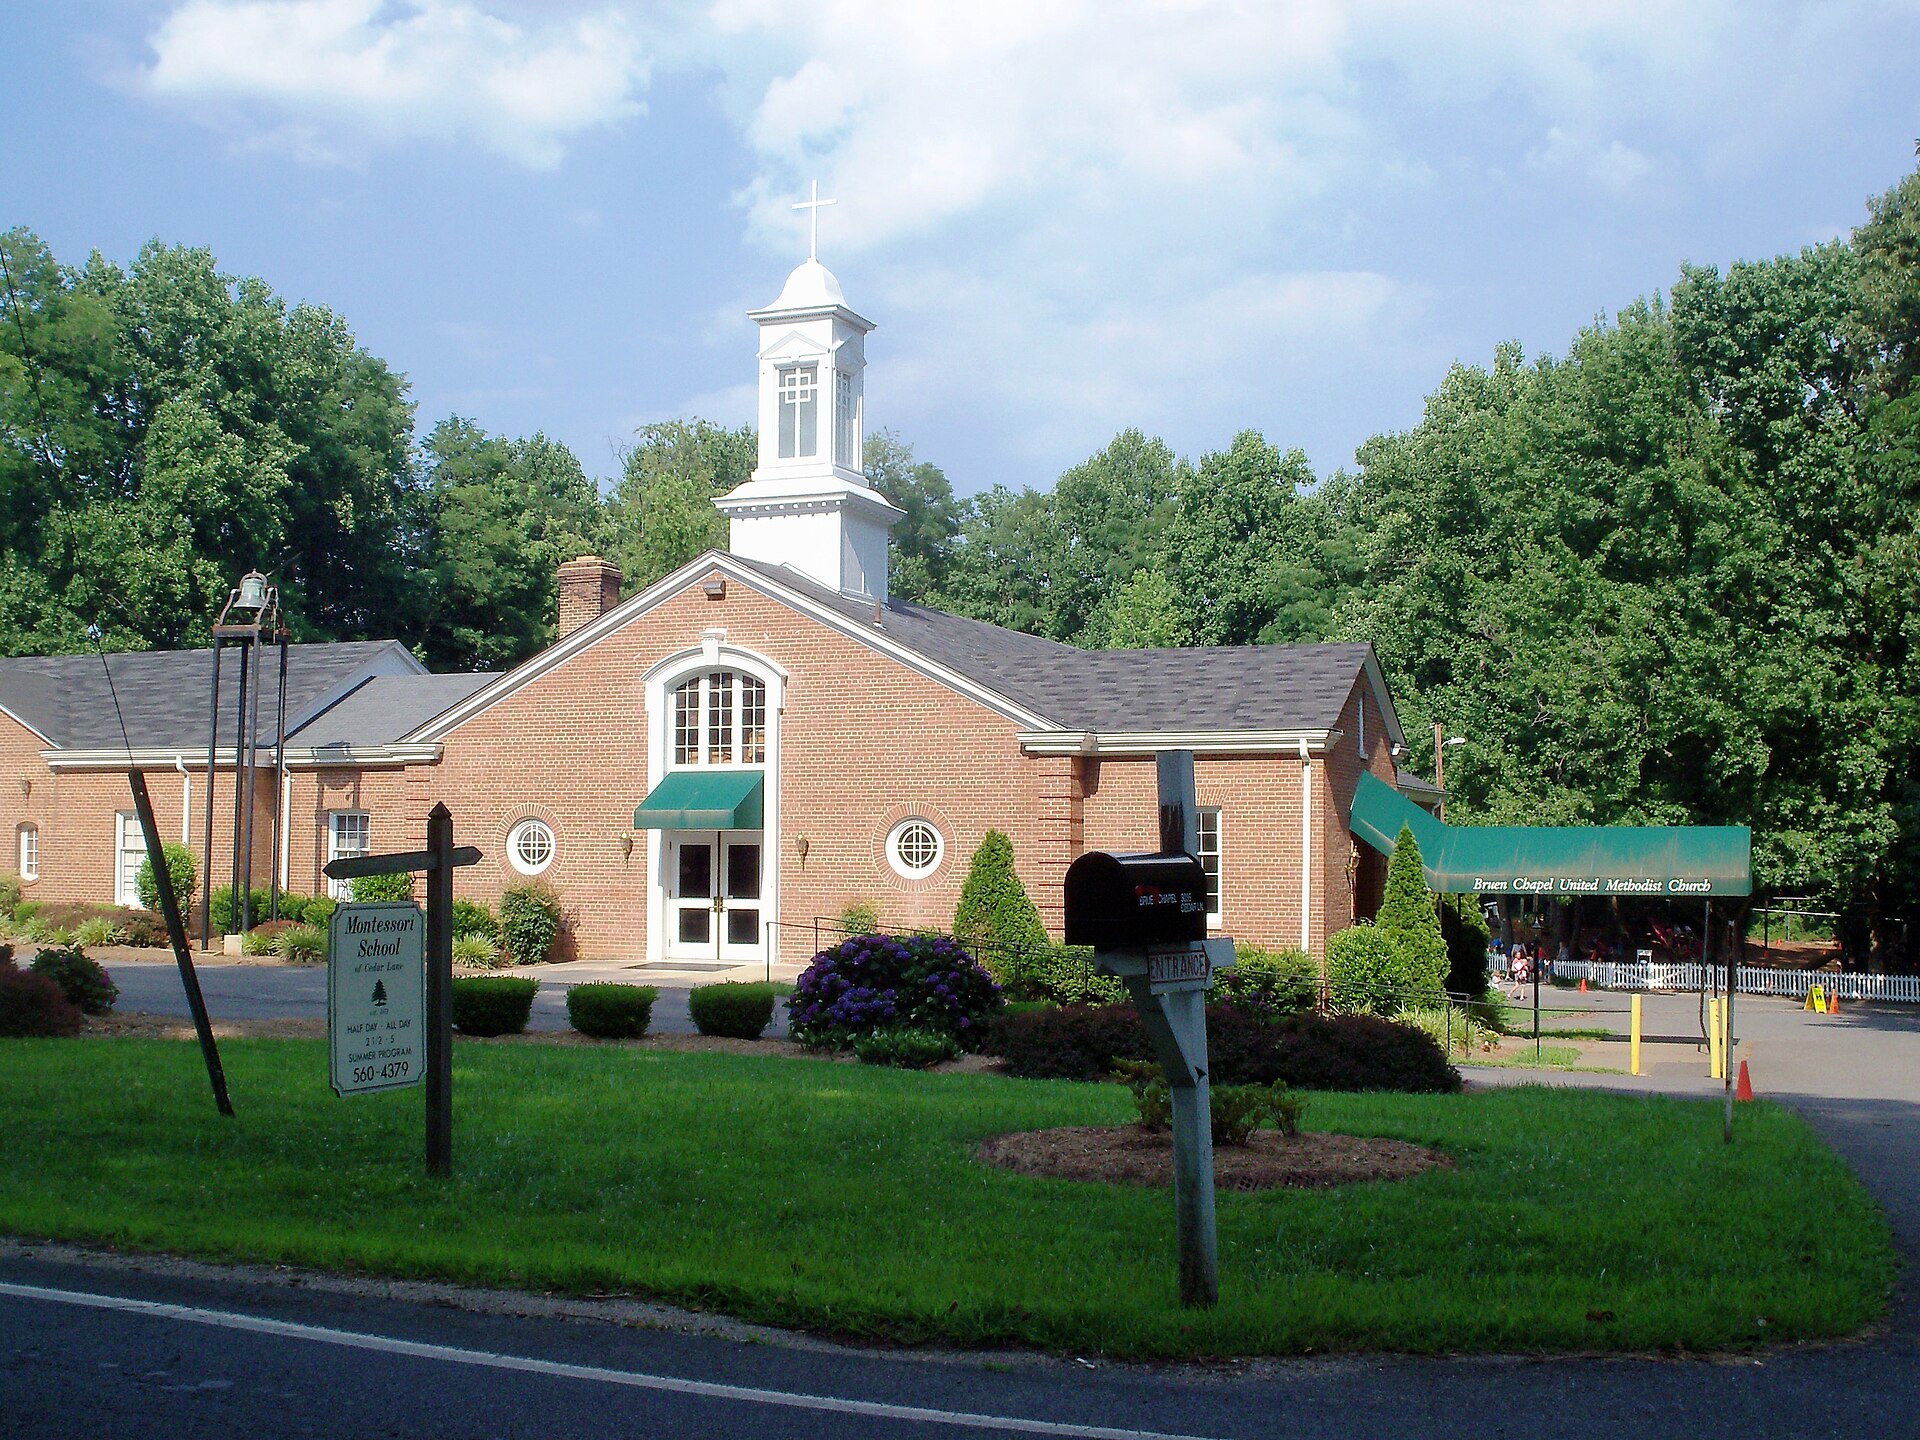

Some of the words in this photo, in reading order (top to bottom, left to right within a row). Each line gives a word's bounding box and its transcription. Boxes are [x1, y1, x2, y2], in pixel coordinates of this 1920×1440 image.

[1473, 877, 1508, 891] Bruen
[1512, 877, 1555, 894] Chapel
[1559, 877, 1600, 892] United
[1605, 878, 1663, 892] Methodist
[1668, 878, 1712, 892] Church
[344, 914, 415, 935] Montessori
[357, 937, 401, 958] School
[354, 963, 363, 973] of
[364, 962, 385, 973] Cedar
[386, 961, 404, 972] Lane
[1150, 954, 1205, 979] ENTRANCE
[347, 1023, 364, 1034] HALF
[365, 1022, 379, 1033] DAY
[385, 1020, 397, 1030] ALL
[398, 1019, 412, 1029] DAY
[389, 1034, 395, 1044] 5
[348, 1051, 377, 1063] SUMMER
[378, 1047, 413, 1059] PROGRAM
[352, 1061, 410, 1084] 560-4379
